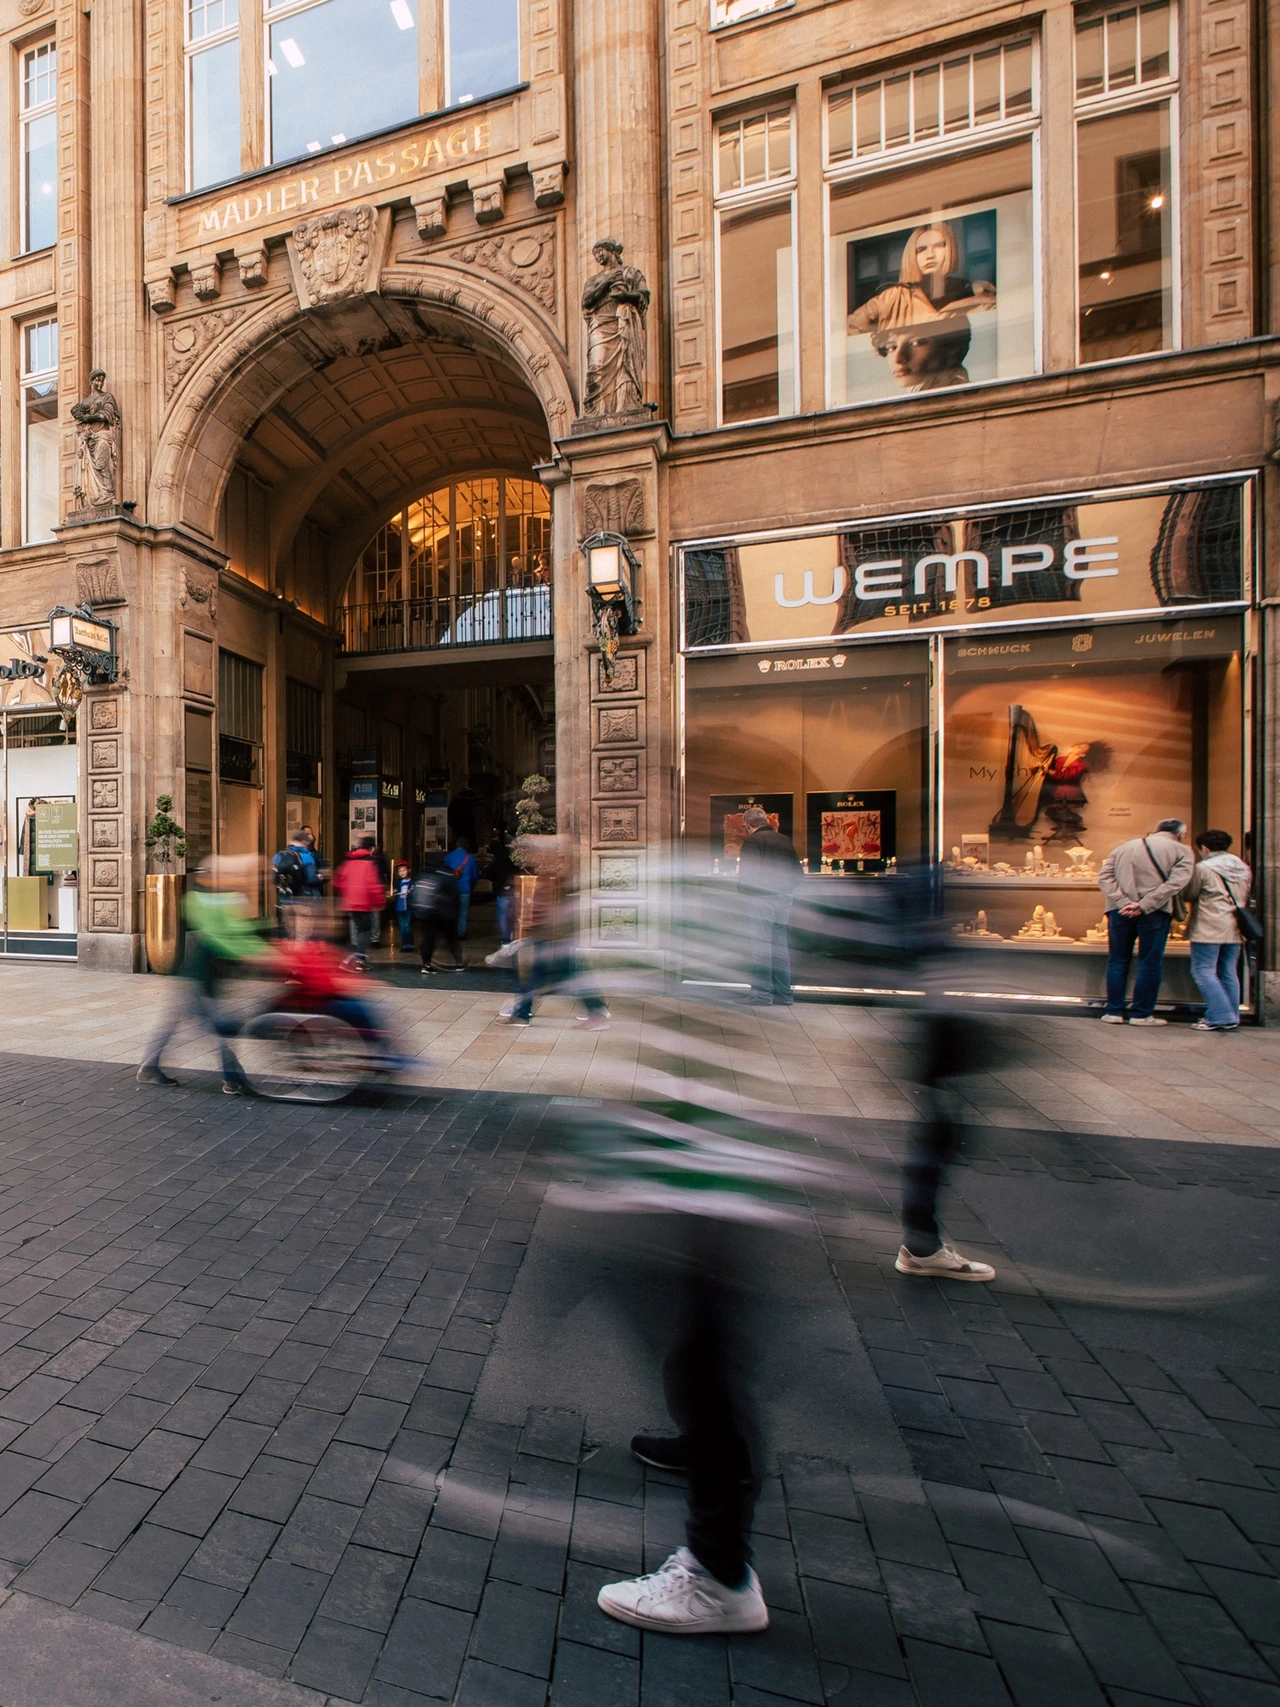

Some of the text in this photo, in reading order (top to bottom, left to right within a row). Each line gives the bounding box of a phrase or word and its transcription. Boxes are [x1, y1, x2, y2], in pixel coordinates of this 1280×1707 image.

[198, 120, 492, 237] MÄDLER PASSAGE
[774, 536, 1119, 609] WEMPE
[884, 597, 992, 617] SEIT 1878
[1135, 629, 1216, 645] JUWELEN
[957, 643, 1031, 658] SCHMUCK
[773, 656, 831, 672] ROLEX
[969, 766, 998, 782] My
[836, 800, 865, 808] ROLEX
